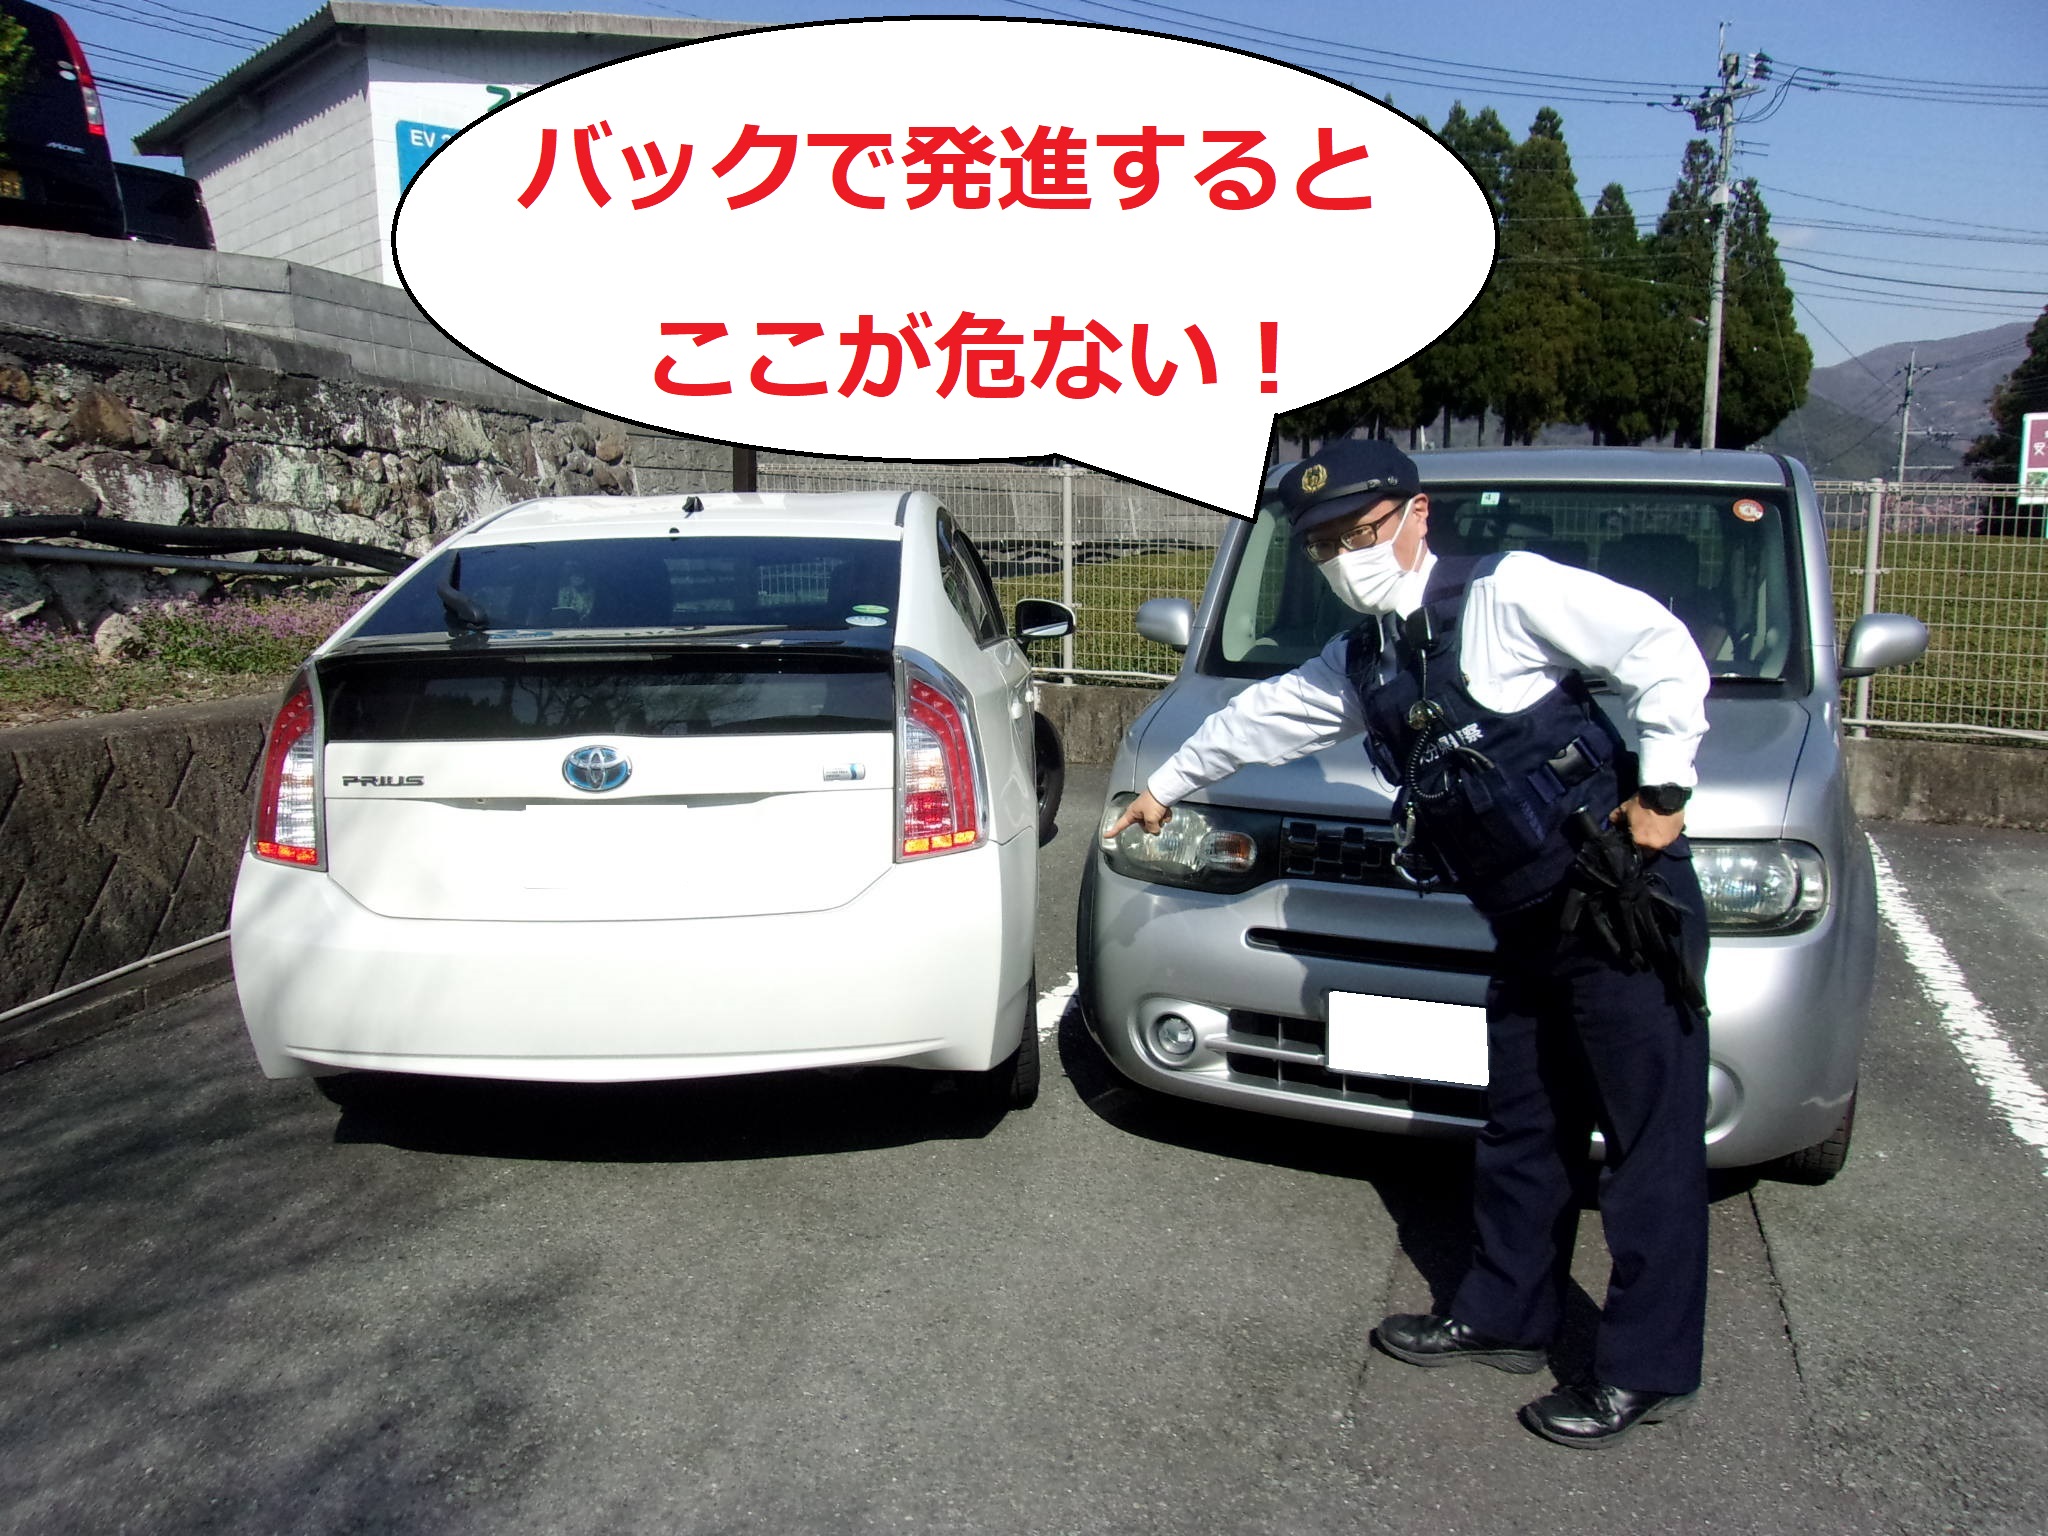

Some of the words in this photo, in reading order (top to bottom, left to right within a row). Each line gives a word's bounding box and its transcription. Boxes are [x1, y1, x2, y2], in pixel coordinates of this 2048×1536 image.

[409, 129, 436, 149] EV
[1420, 722, 1484, 765] 分県察
[342, 775, 425, 787] PRIUS
